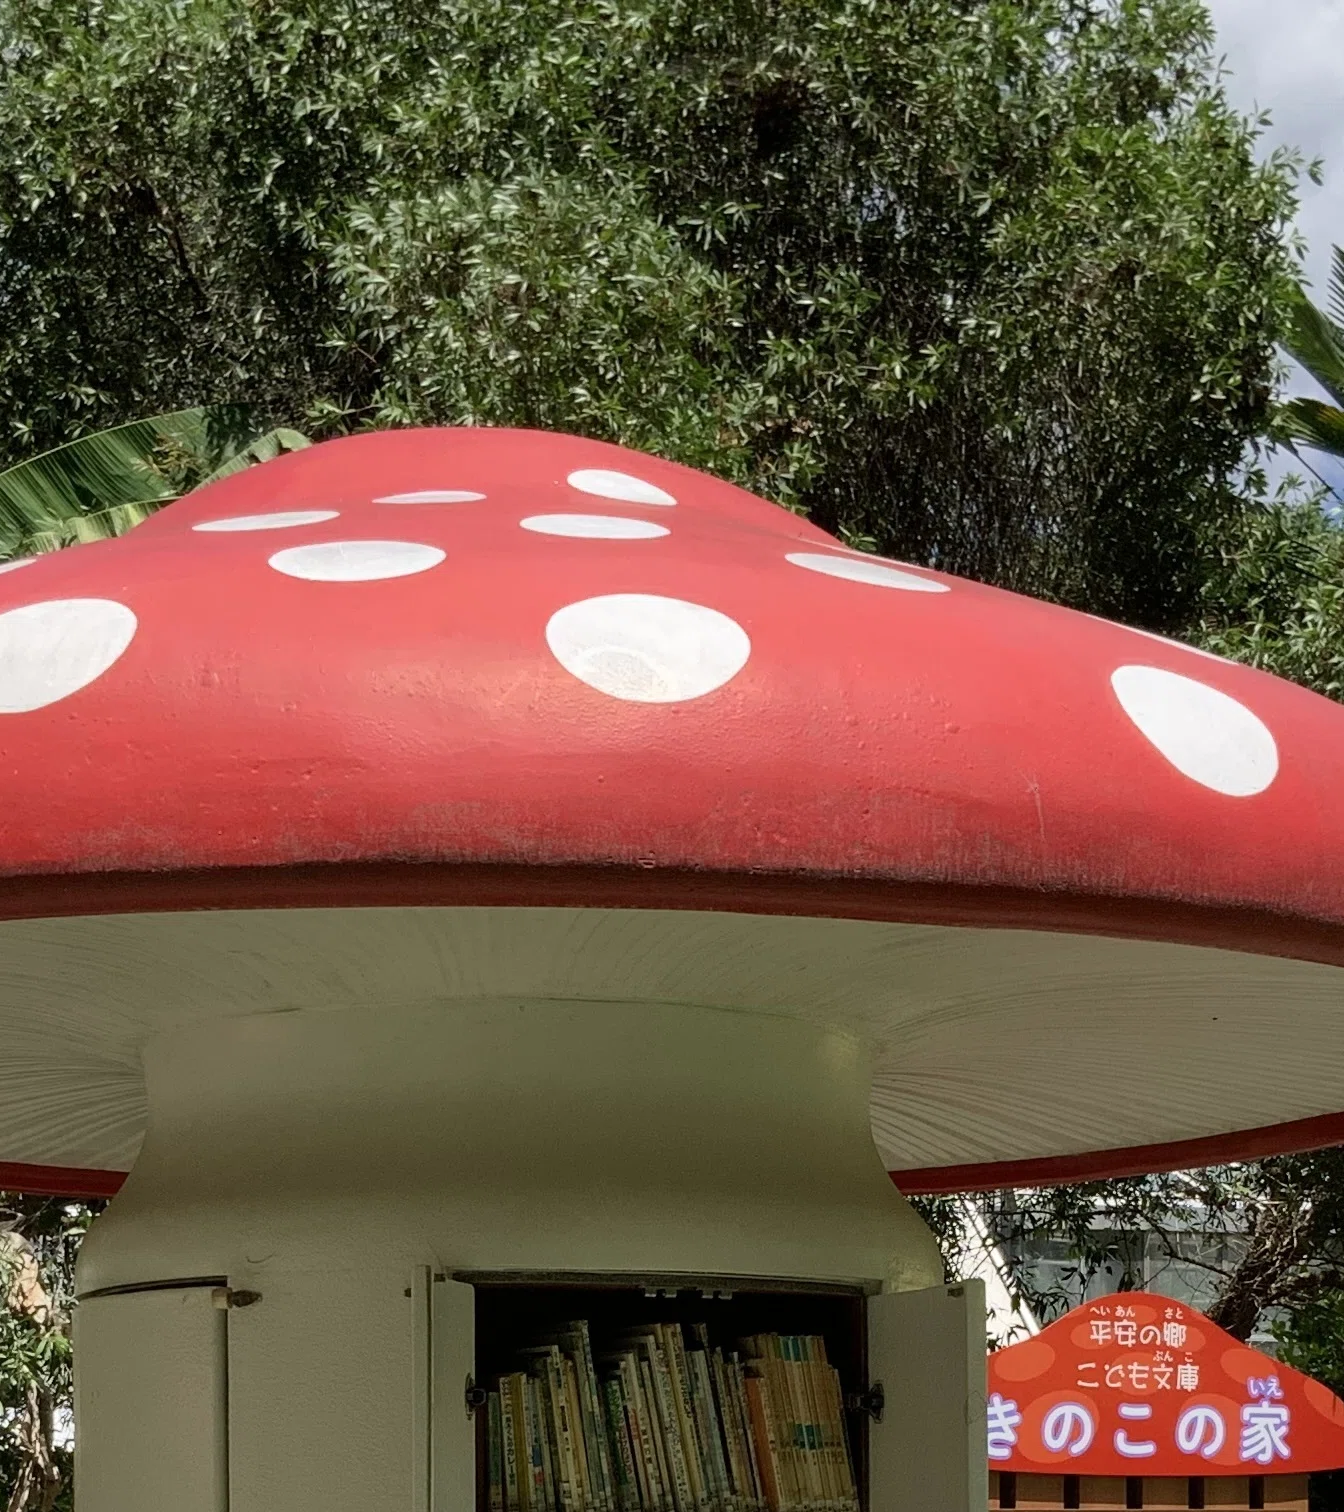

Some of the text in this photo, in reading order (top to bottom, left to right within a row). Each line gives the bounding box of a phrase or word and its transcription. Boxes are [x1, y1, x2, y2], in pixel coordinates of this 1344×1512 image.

[1090, 1306, 1111, 1316] へい
[1164, 1307, 1183, 1319] さと
[1090, 1319, 1187, 1348] 平安の郷
[1076, 1362, 1200, 1393] こども文庫
[1247, 1375, 1283, 1397] いえ
[988, 1394, 1290, 1463] きのこの家
